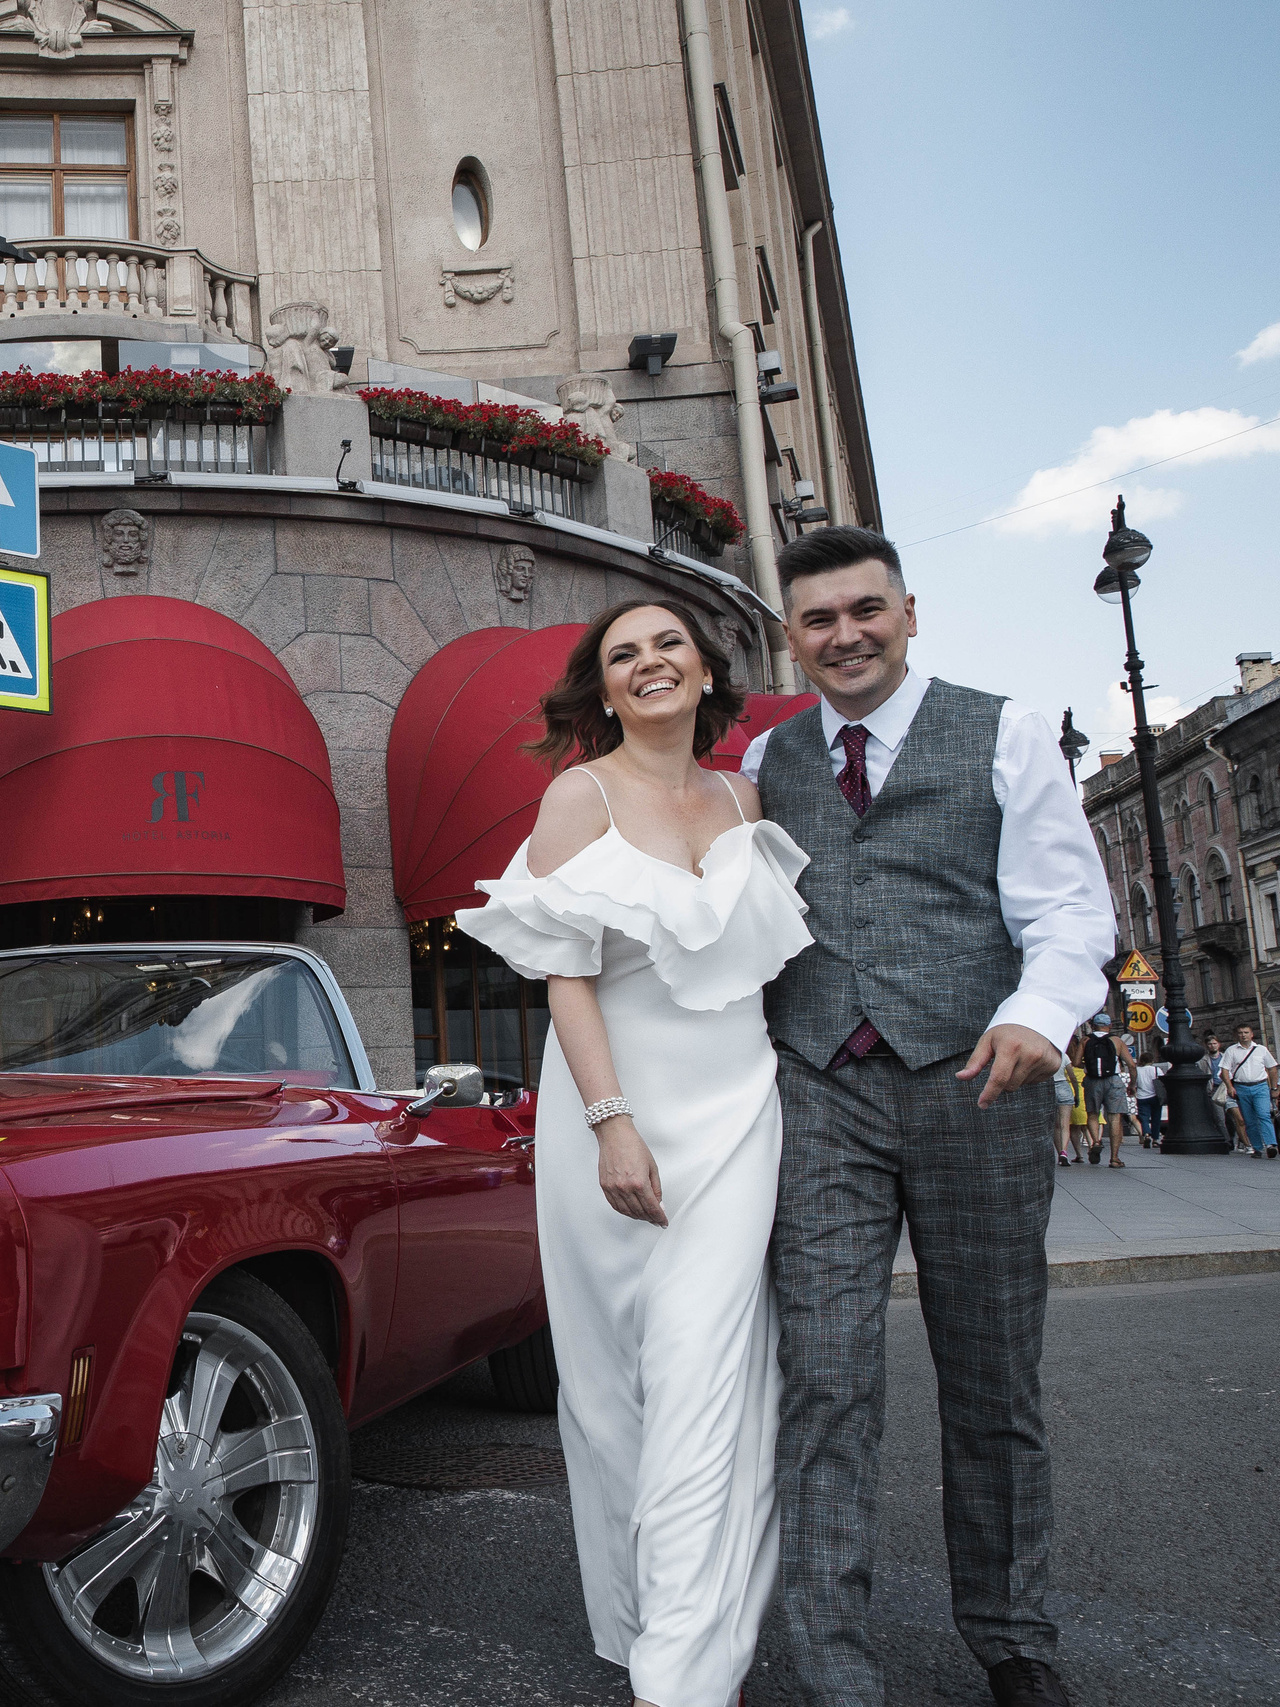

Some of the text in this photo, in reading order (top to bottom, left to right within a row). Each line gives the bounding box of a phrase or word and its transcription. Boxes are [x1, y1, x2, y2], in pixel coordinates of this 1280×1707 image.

[122, 830, 231, 841] HOTEL ASTORIA
[1131, 1011, 1148, 1023] 40
